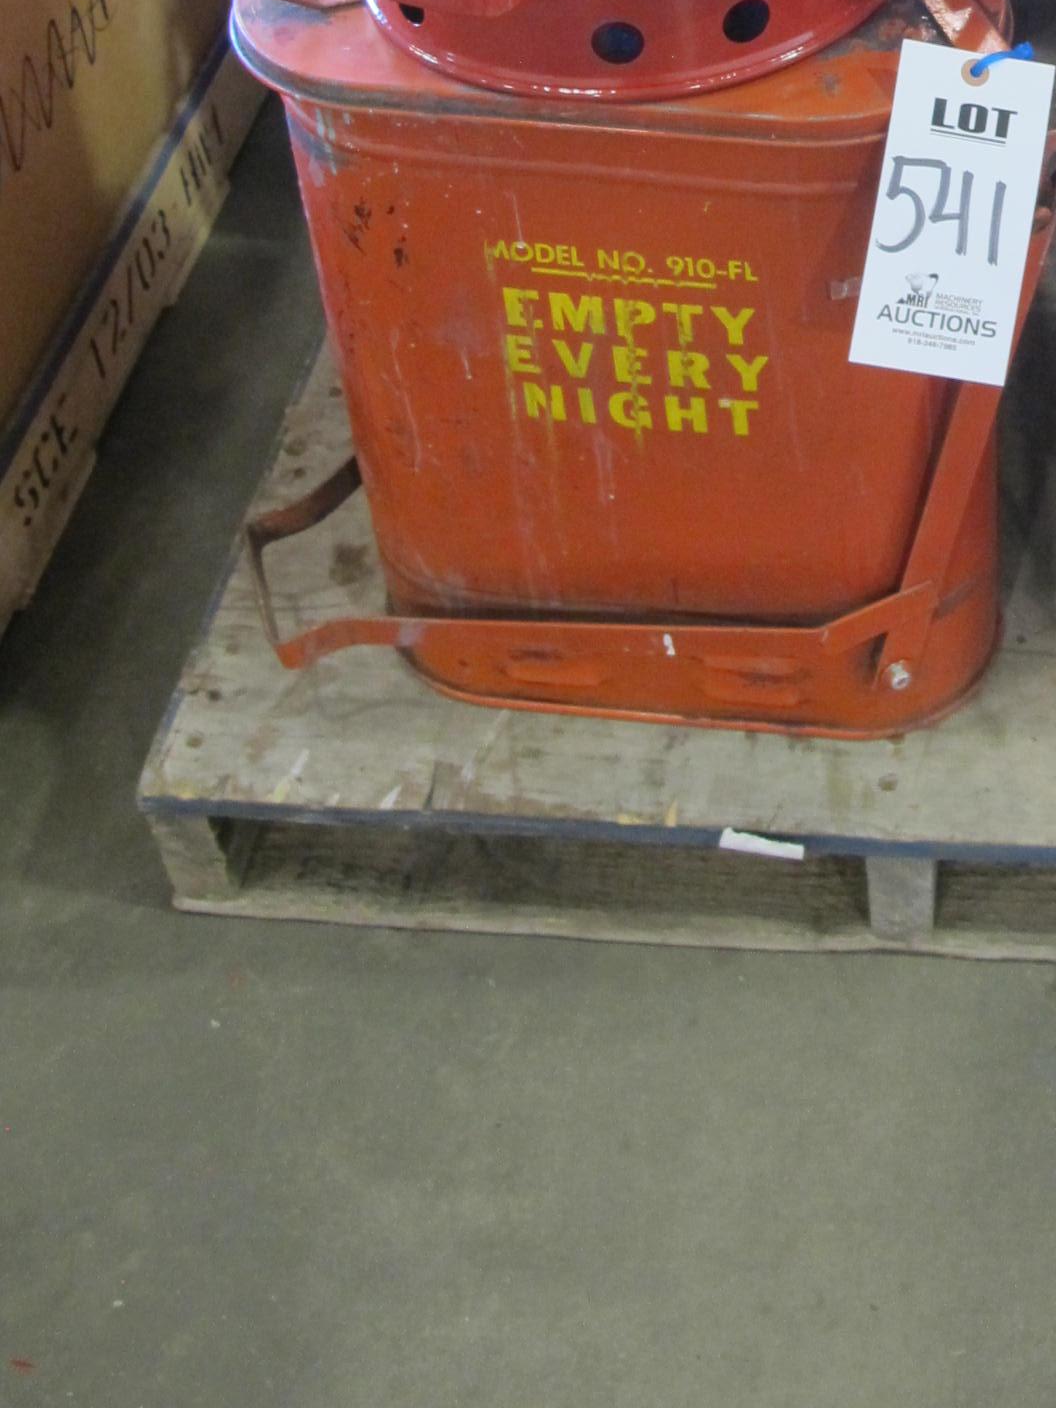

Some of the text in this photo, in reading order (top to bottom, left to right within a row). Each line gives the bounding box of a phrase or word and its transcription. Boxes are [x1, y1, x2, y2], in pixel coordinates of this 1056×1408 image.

[931, 97, 1018, 139] LOT
[875, 155, 1007, 266] 541
[597, 248, 653, 273] NO.
[666, 255, 759, 282] 910-FL
[503, 287, 755, 345] EMPTY
[906, 293, 929, 308] MRI
[936, 292, 983, 305] MACHINERY
[877, 303, 998, 338] AUCTIONS
[505, 333, 769, 392] EVERY
[523, 382, 759, 436] NIGHT
